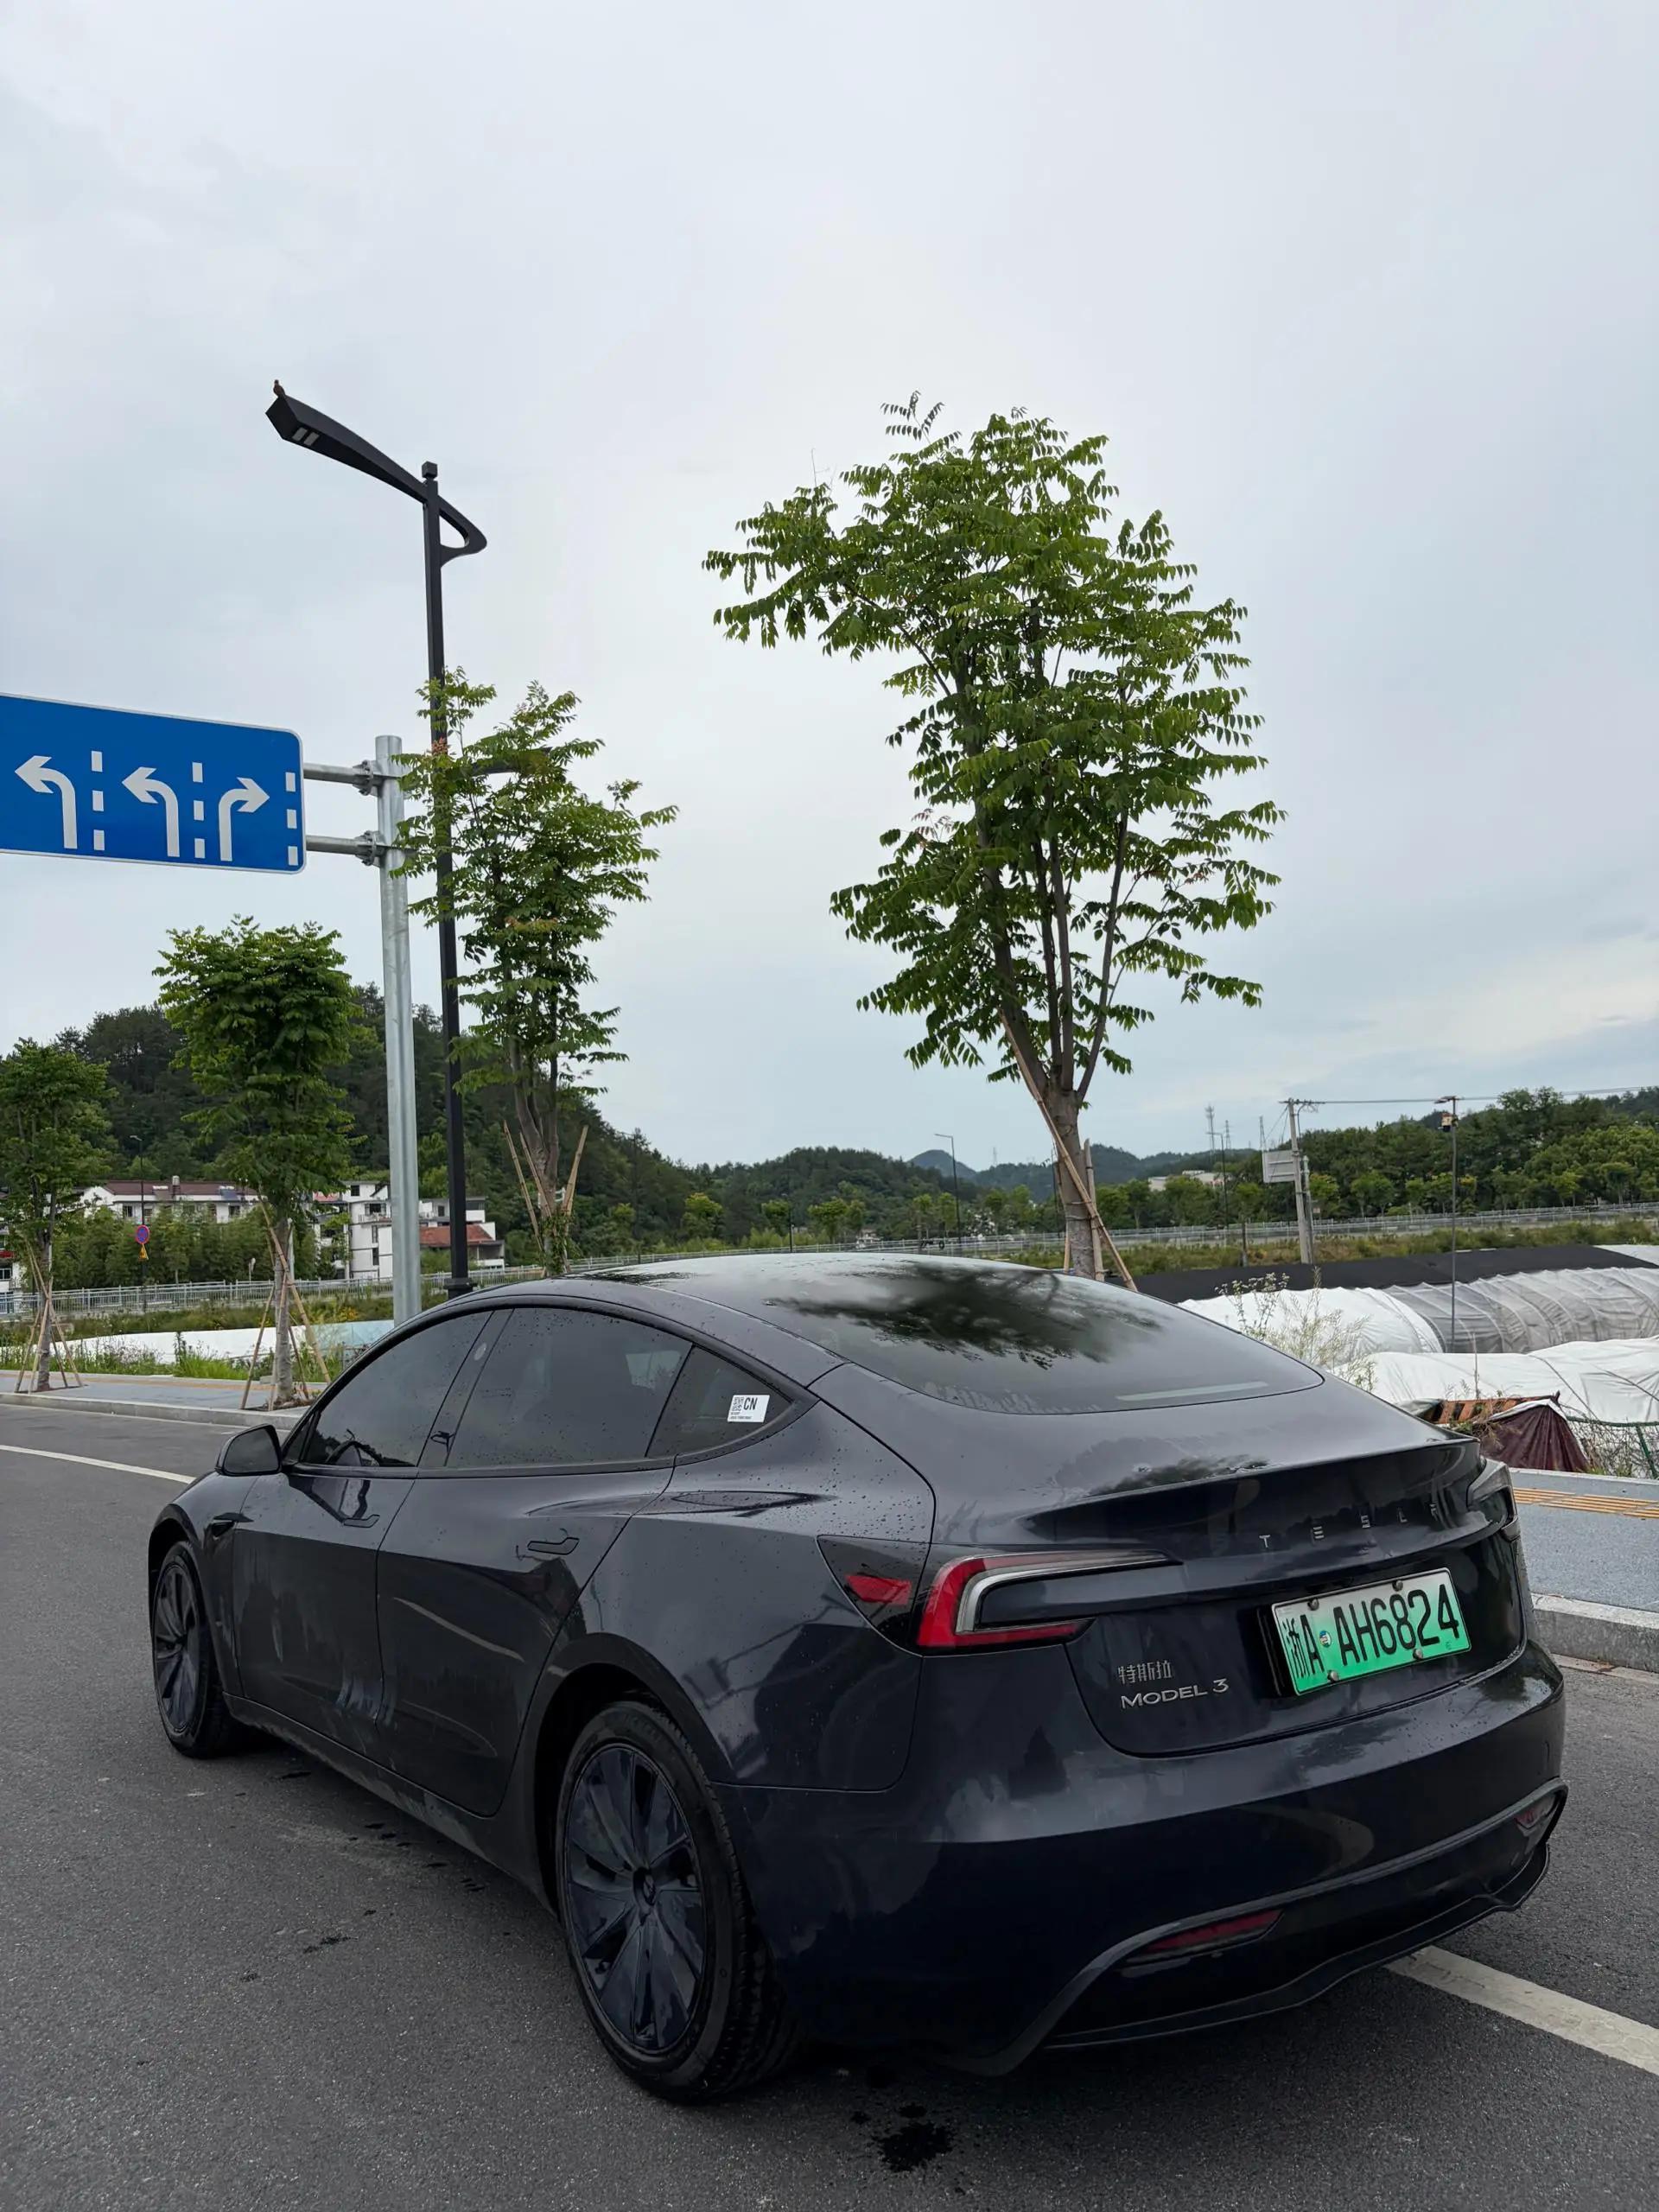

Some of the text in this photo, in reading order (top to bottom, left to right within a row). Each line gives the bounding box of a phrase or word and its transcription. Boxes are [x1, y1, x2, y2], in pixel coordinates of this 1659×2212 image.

[743, 1397, 758, 1410] CN
[1259, 1503, 1438, 1548] TESLA
[1333, 1584, 1460, 1666] AH6824
[1117, 1660, 1172, 1684] 特斯拉
[1121, 1678, 1230, 1709] MODEL 3
